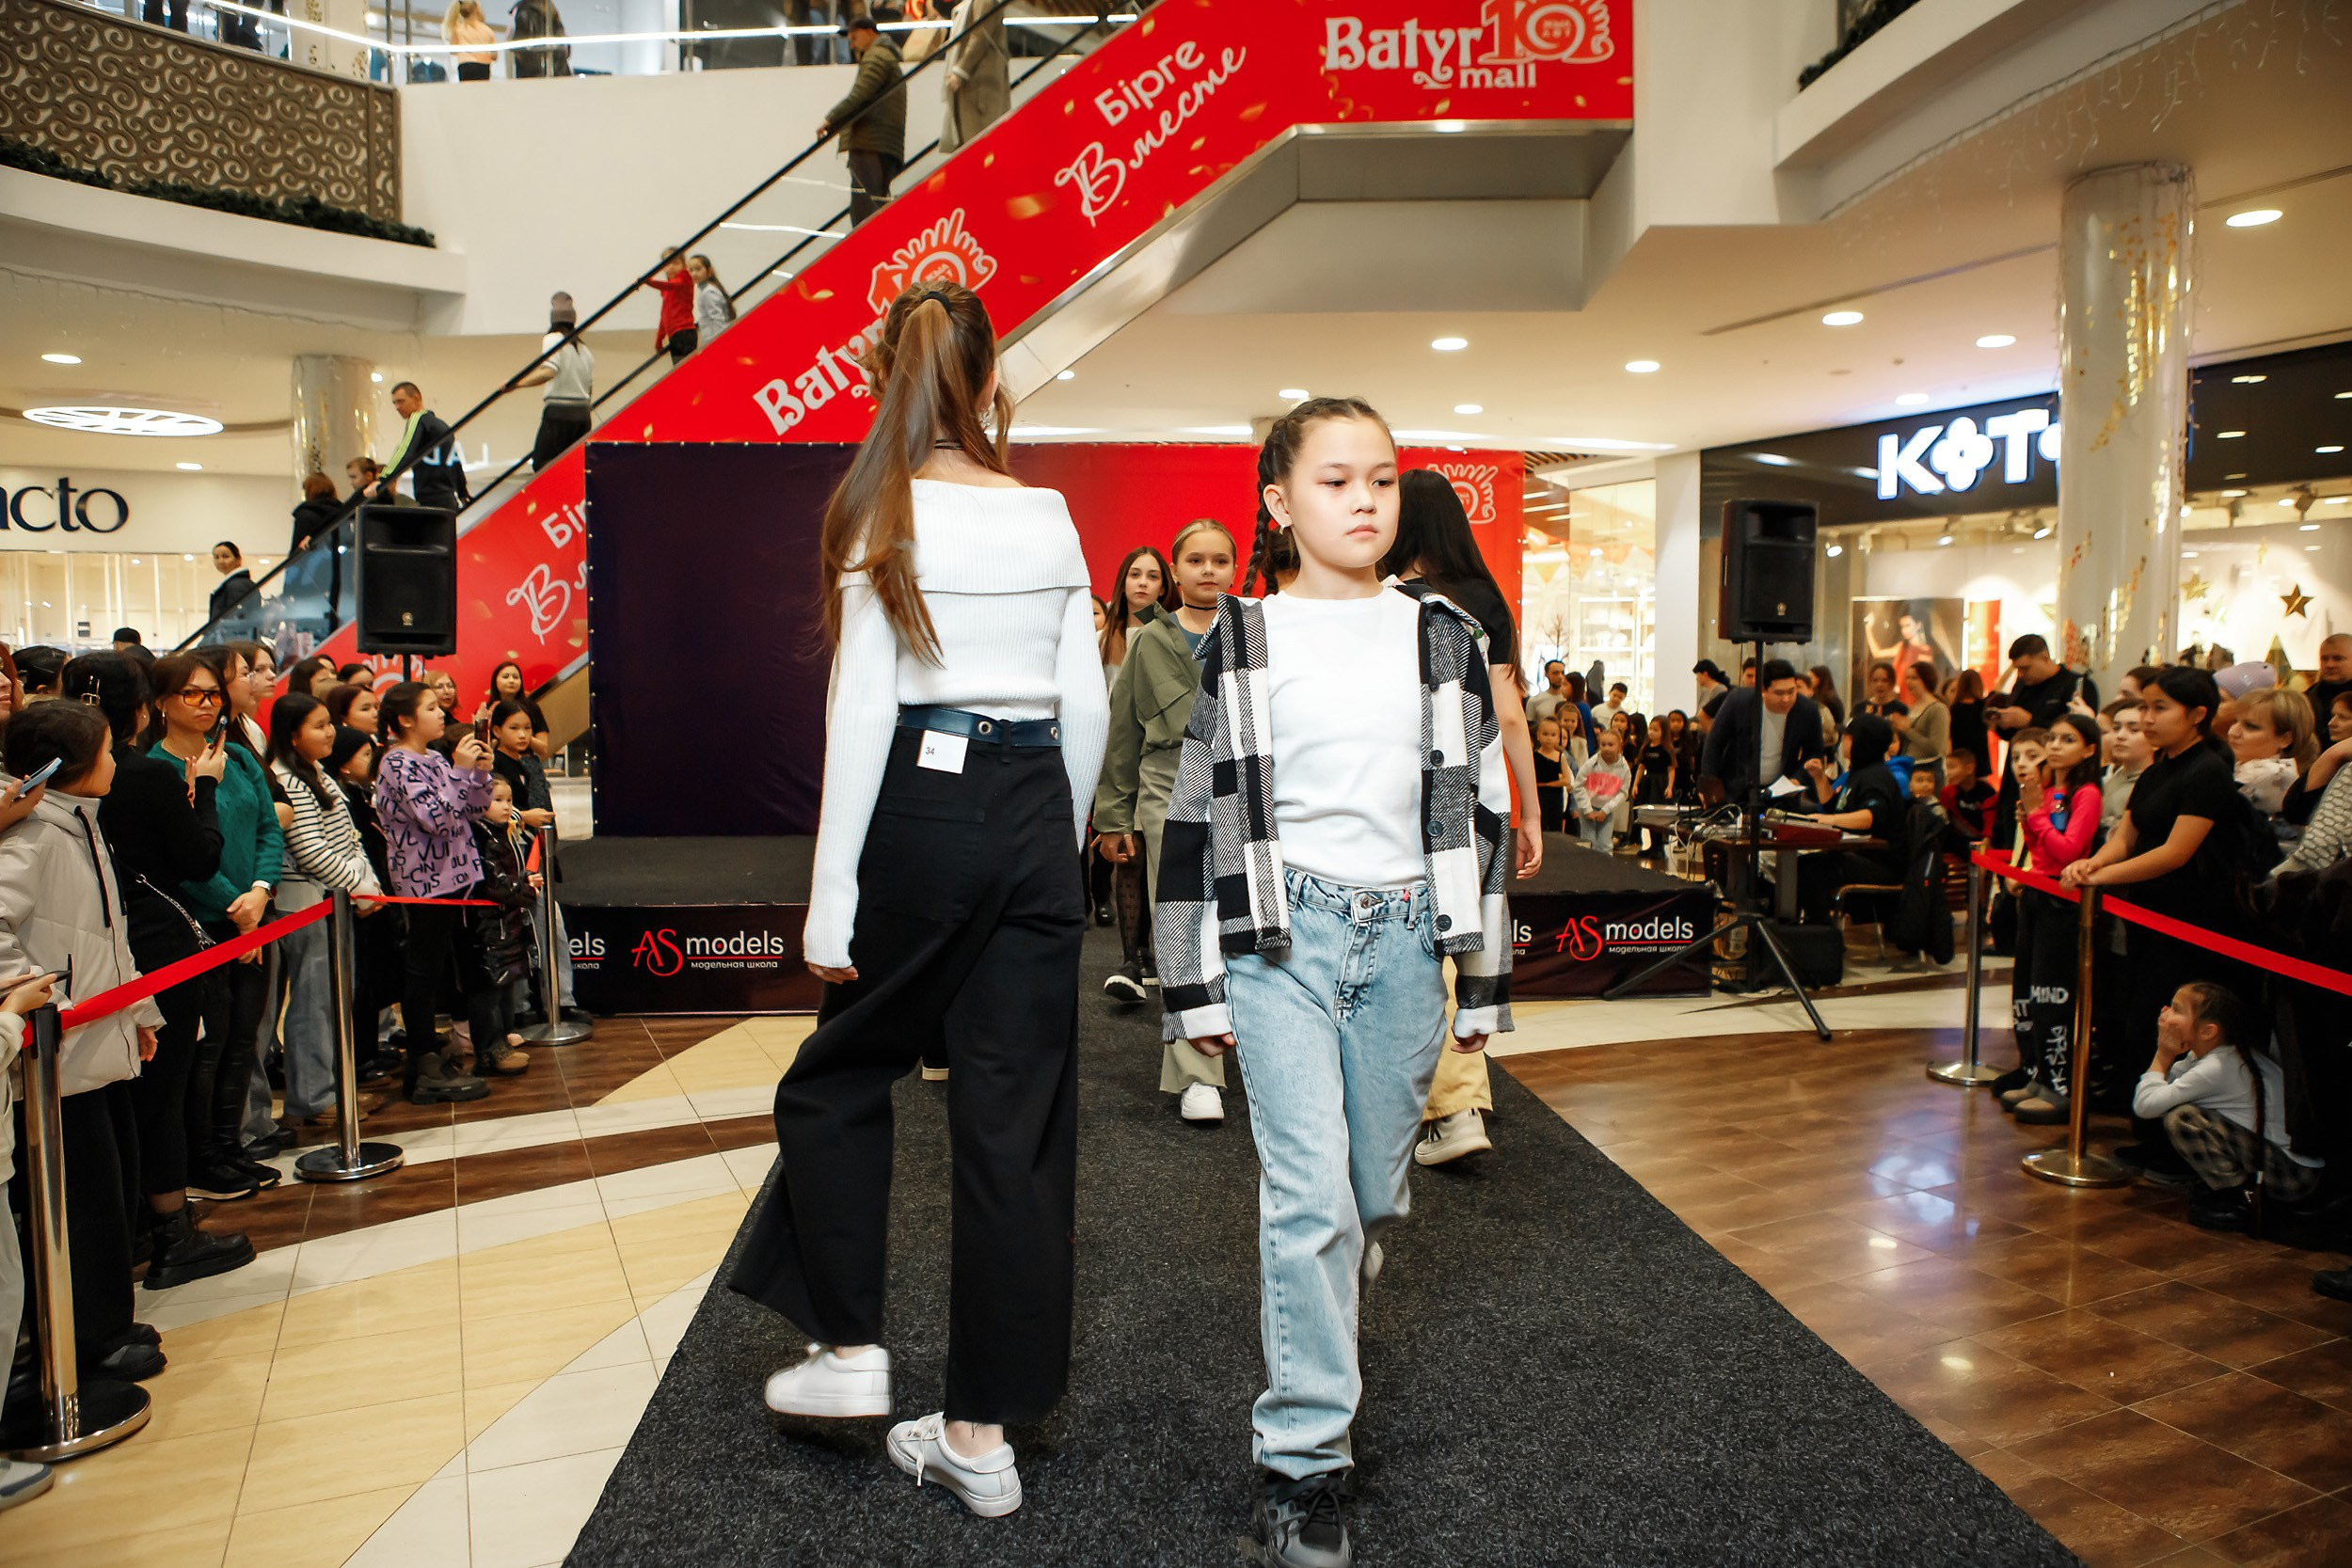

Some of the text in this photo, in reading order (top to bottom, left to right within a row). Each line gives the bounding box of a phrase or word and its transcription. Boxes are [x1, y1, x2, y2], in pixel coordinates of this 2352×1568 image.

[1325, 16, 1484, 89] Batyr
[1459, 63, 1536, 88] mall
[1094, 41, 1205, 127] Бірге
[1054, 45, 1247, 228] Вместе
[0, 477, 129, 532] cto
[925, 746, 935, 755] 34
[631, 928, 784, 976] AS models
[1555, 915, 1693, 961] AS models
[1609, 945, 1658, 955] модельная
[691, 961, 744, 971] модельная
